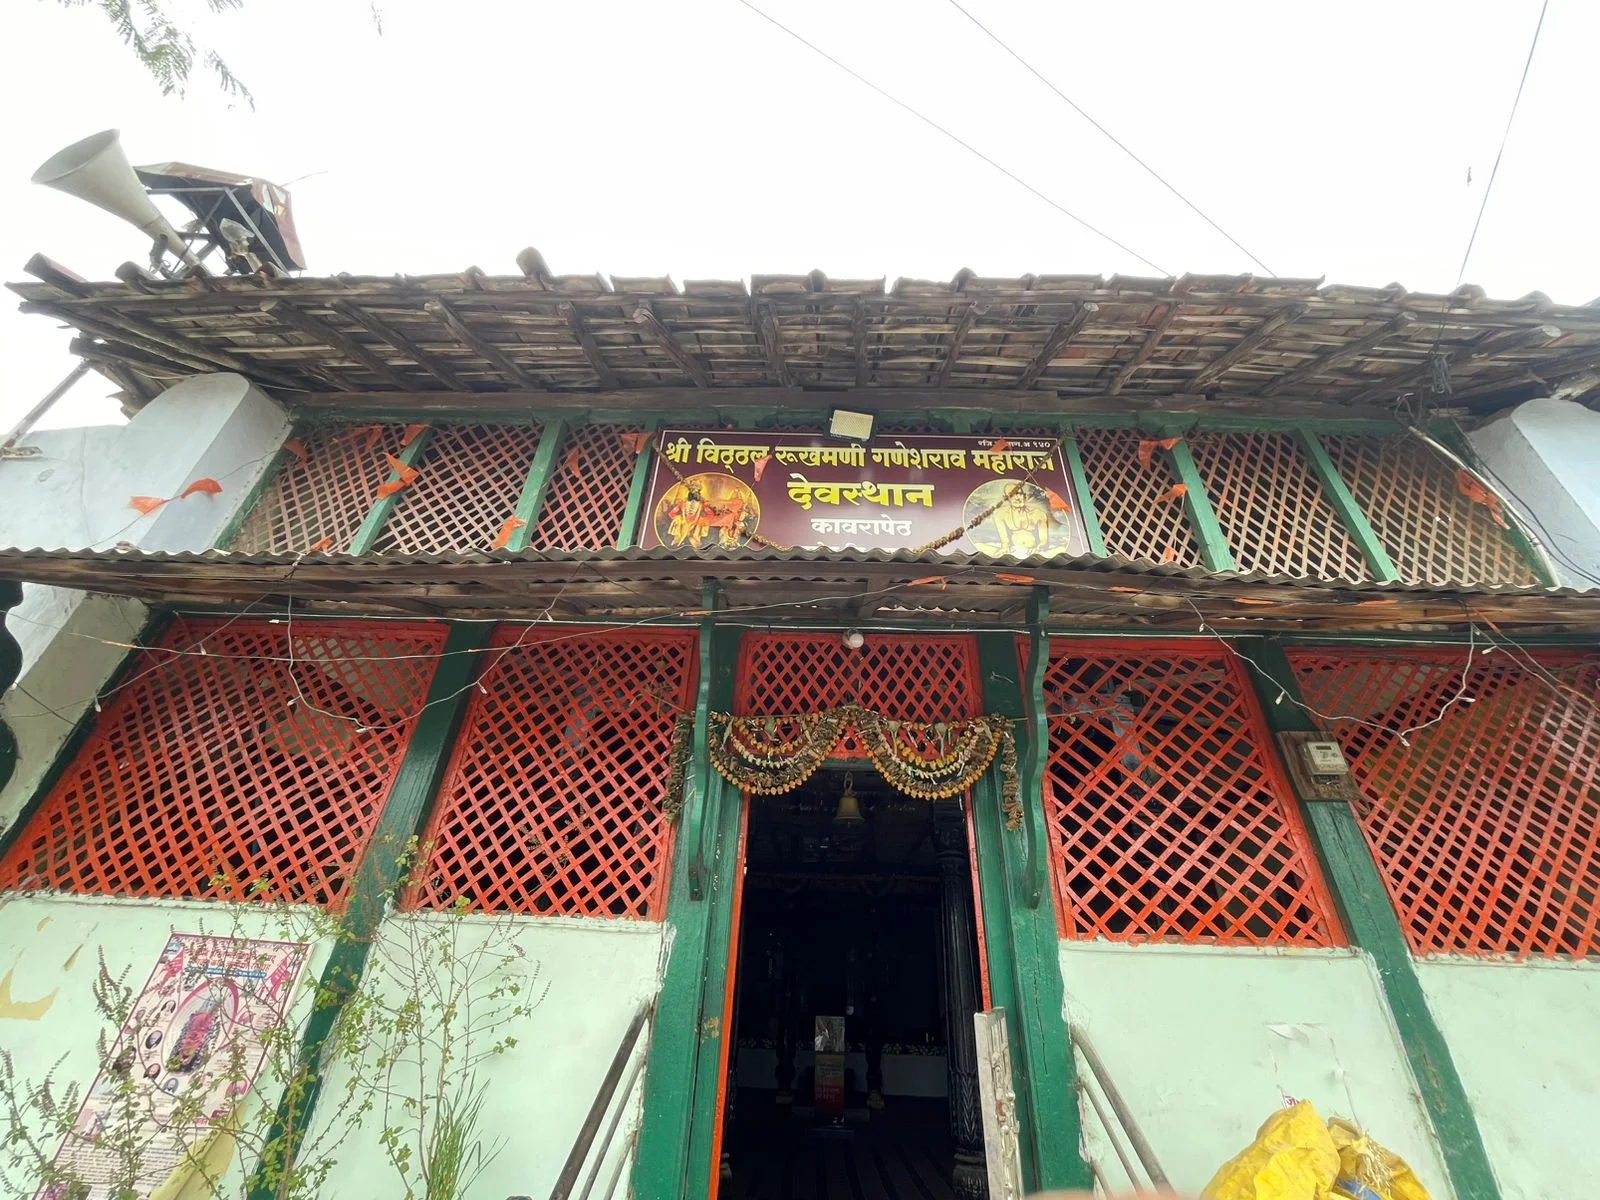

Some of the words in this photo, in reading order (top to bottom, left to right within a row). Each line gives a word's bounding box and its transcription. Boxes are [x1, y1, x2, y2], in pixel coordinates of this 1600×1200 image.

[666, 437, 692, 464] श्री
[774, 443, 867, 467] रूखमणी
[871, 441, 966, 469] गणेशराव
[971, 449, 1055, 475] महाराज
[787, 472, 935, 511] देवस्थान
[810, 513, 913, 537] कावरापेठ
